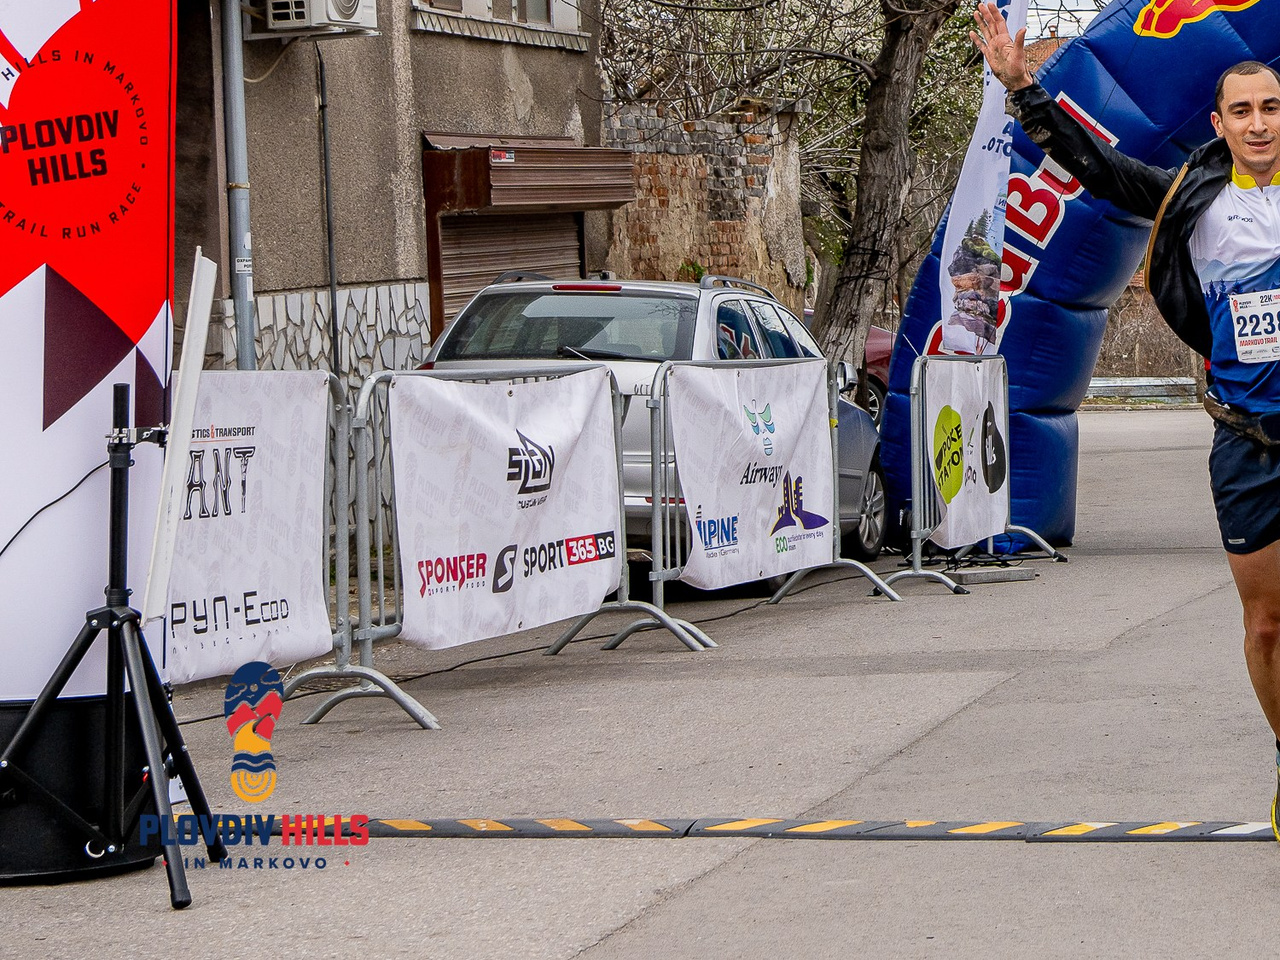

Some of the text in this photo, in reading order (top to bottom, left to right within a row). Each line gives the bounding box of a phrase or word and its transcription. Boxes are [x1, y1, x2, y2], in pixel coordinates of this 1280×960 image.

[1, 50, 148, 145] HILLS IN MARKOVO
[0, 109, 119, 154] PLOVDIV
[27, 148, 108, 186] HILLS
[62, 222, 101, 239] RUN
[108, 182, 142, 224] RACE
[774, 535, 789, 554] ECO
[417, 552, 487, 598] SPONSER
